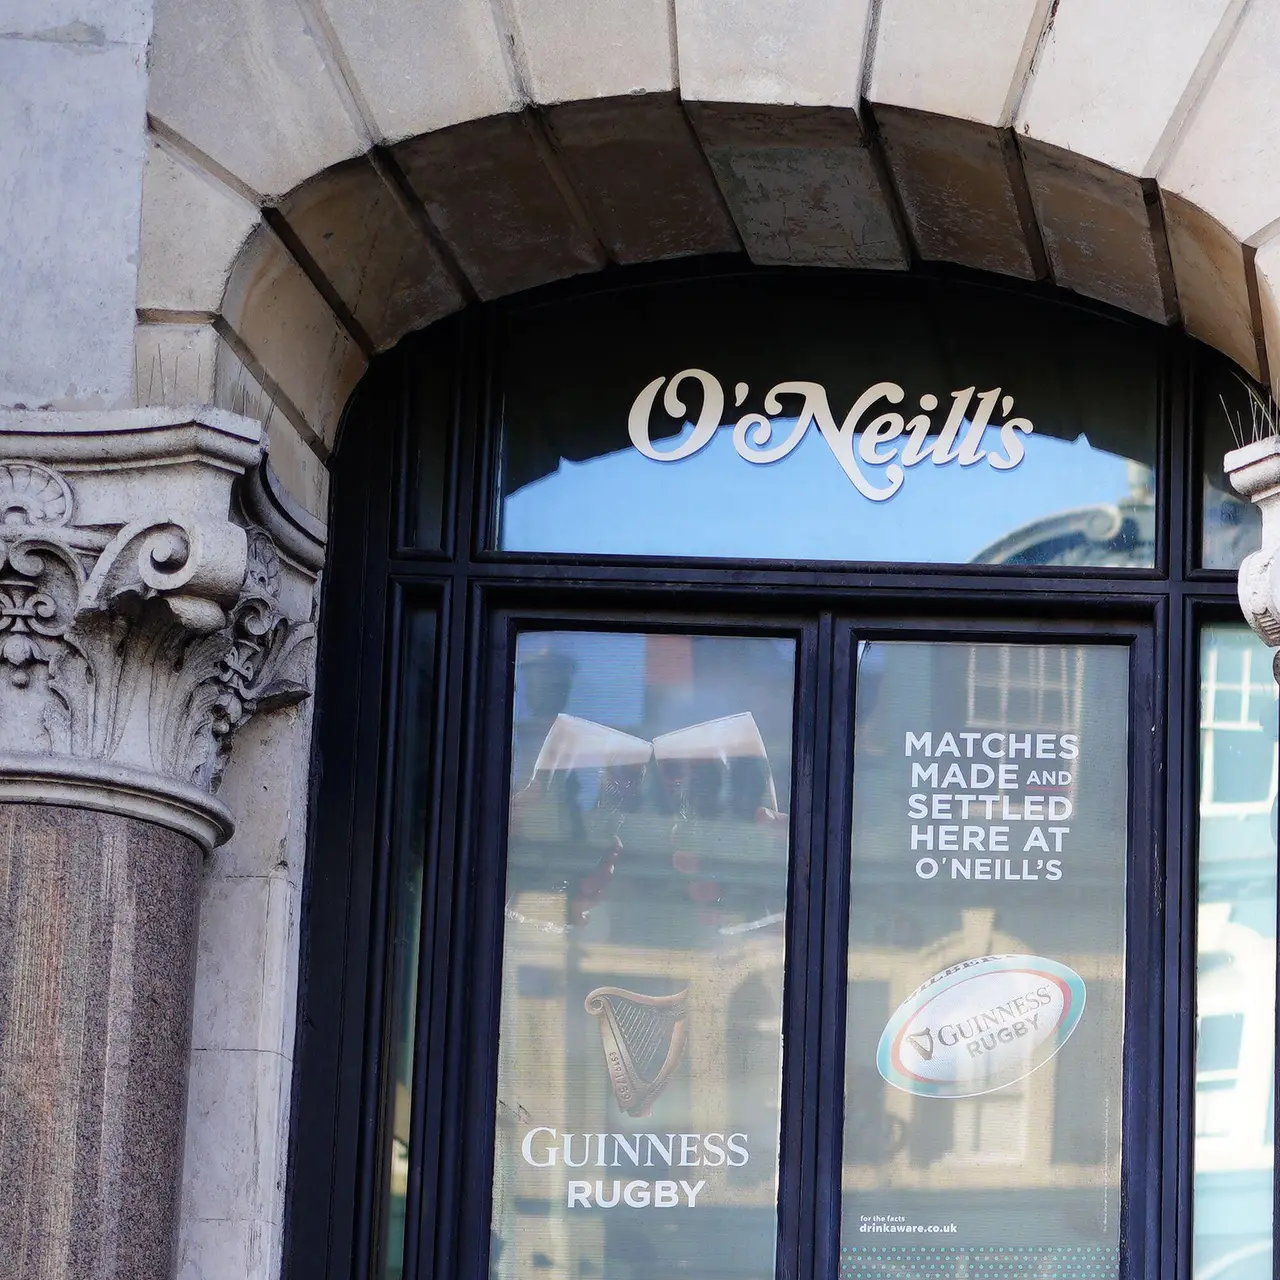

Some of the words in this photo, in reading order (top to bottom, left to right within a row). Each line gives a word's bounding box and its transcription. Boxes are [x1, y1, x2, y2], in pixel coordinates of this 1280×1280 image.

[627, 368, 1034, 501] O'Neill's
[904, 731, 1080, 760] MATCHES
[911, 762, 1019, 789] MADE
[1026, 770, 1072, 785] AND
[907, 794, 1073, 821] SETTLED
[910, 825, 1010, 851] HERE
[1022, 826, 1070, 852] AT
[915, 857, 1063, 881] O'NEILL'S
[937, 985, 1051, 1046] GUINNESS
[966, 1013, 1039, 1058] RUGBY
[521, 1126, 750, 1168] GUINNESS
[567, 1180, 706, 1208] RUGBY
[860, 1222, 957, 1233] drinkaware.co.uk
